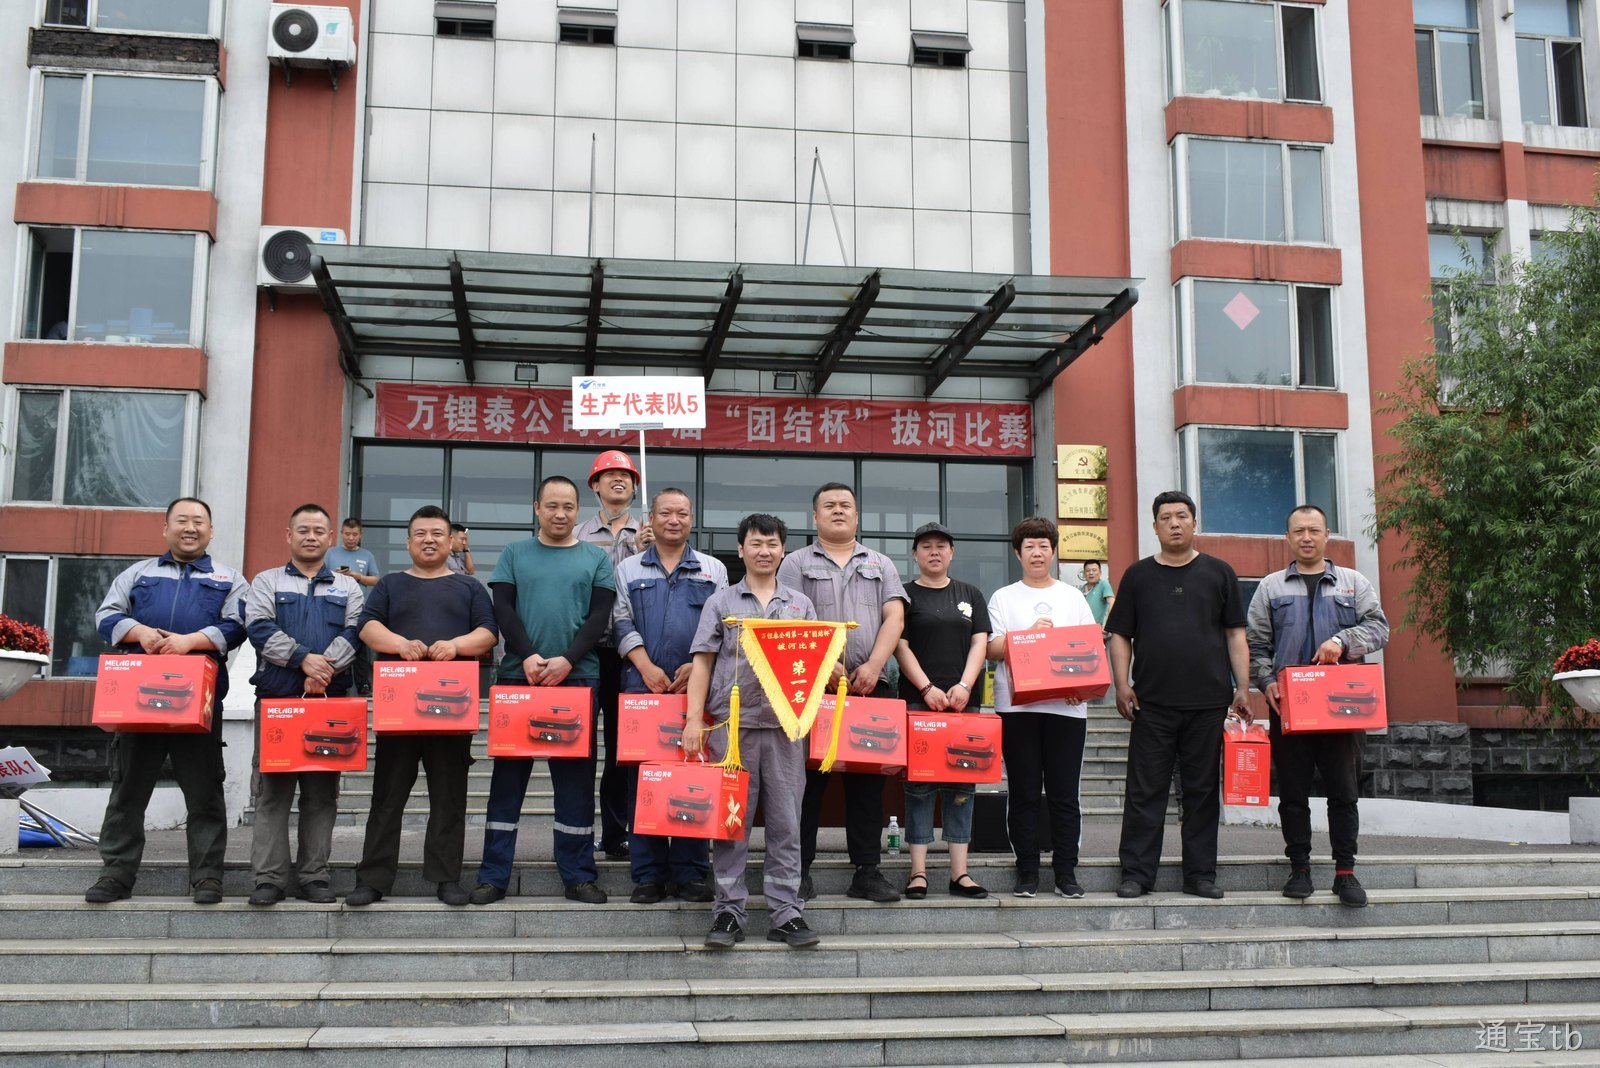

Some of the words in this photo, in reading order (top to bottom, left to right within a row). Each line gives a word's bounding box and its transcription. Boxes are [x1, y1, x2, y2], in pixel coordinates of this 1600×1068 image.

[580, 392, 699, 416] 生产代表队5
[777, 641, 818, 651] 拔河比赛
[790, 659, 808, 704] 第一名
